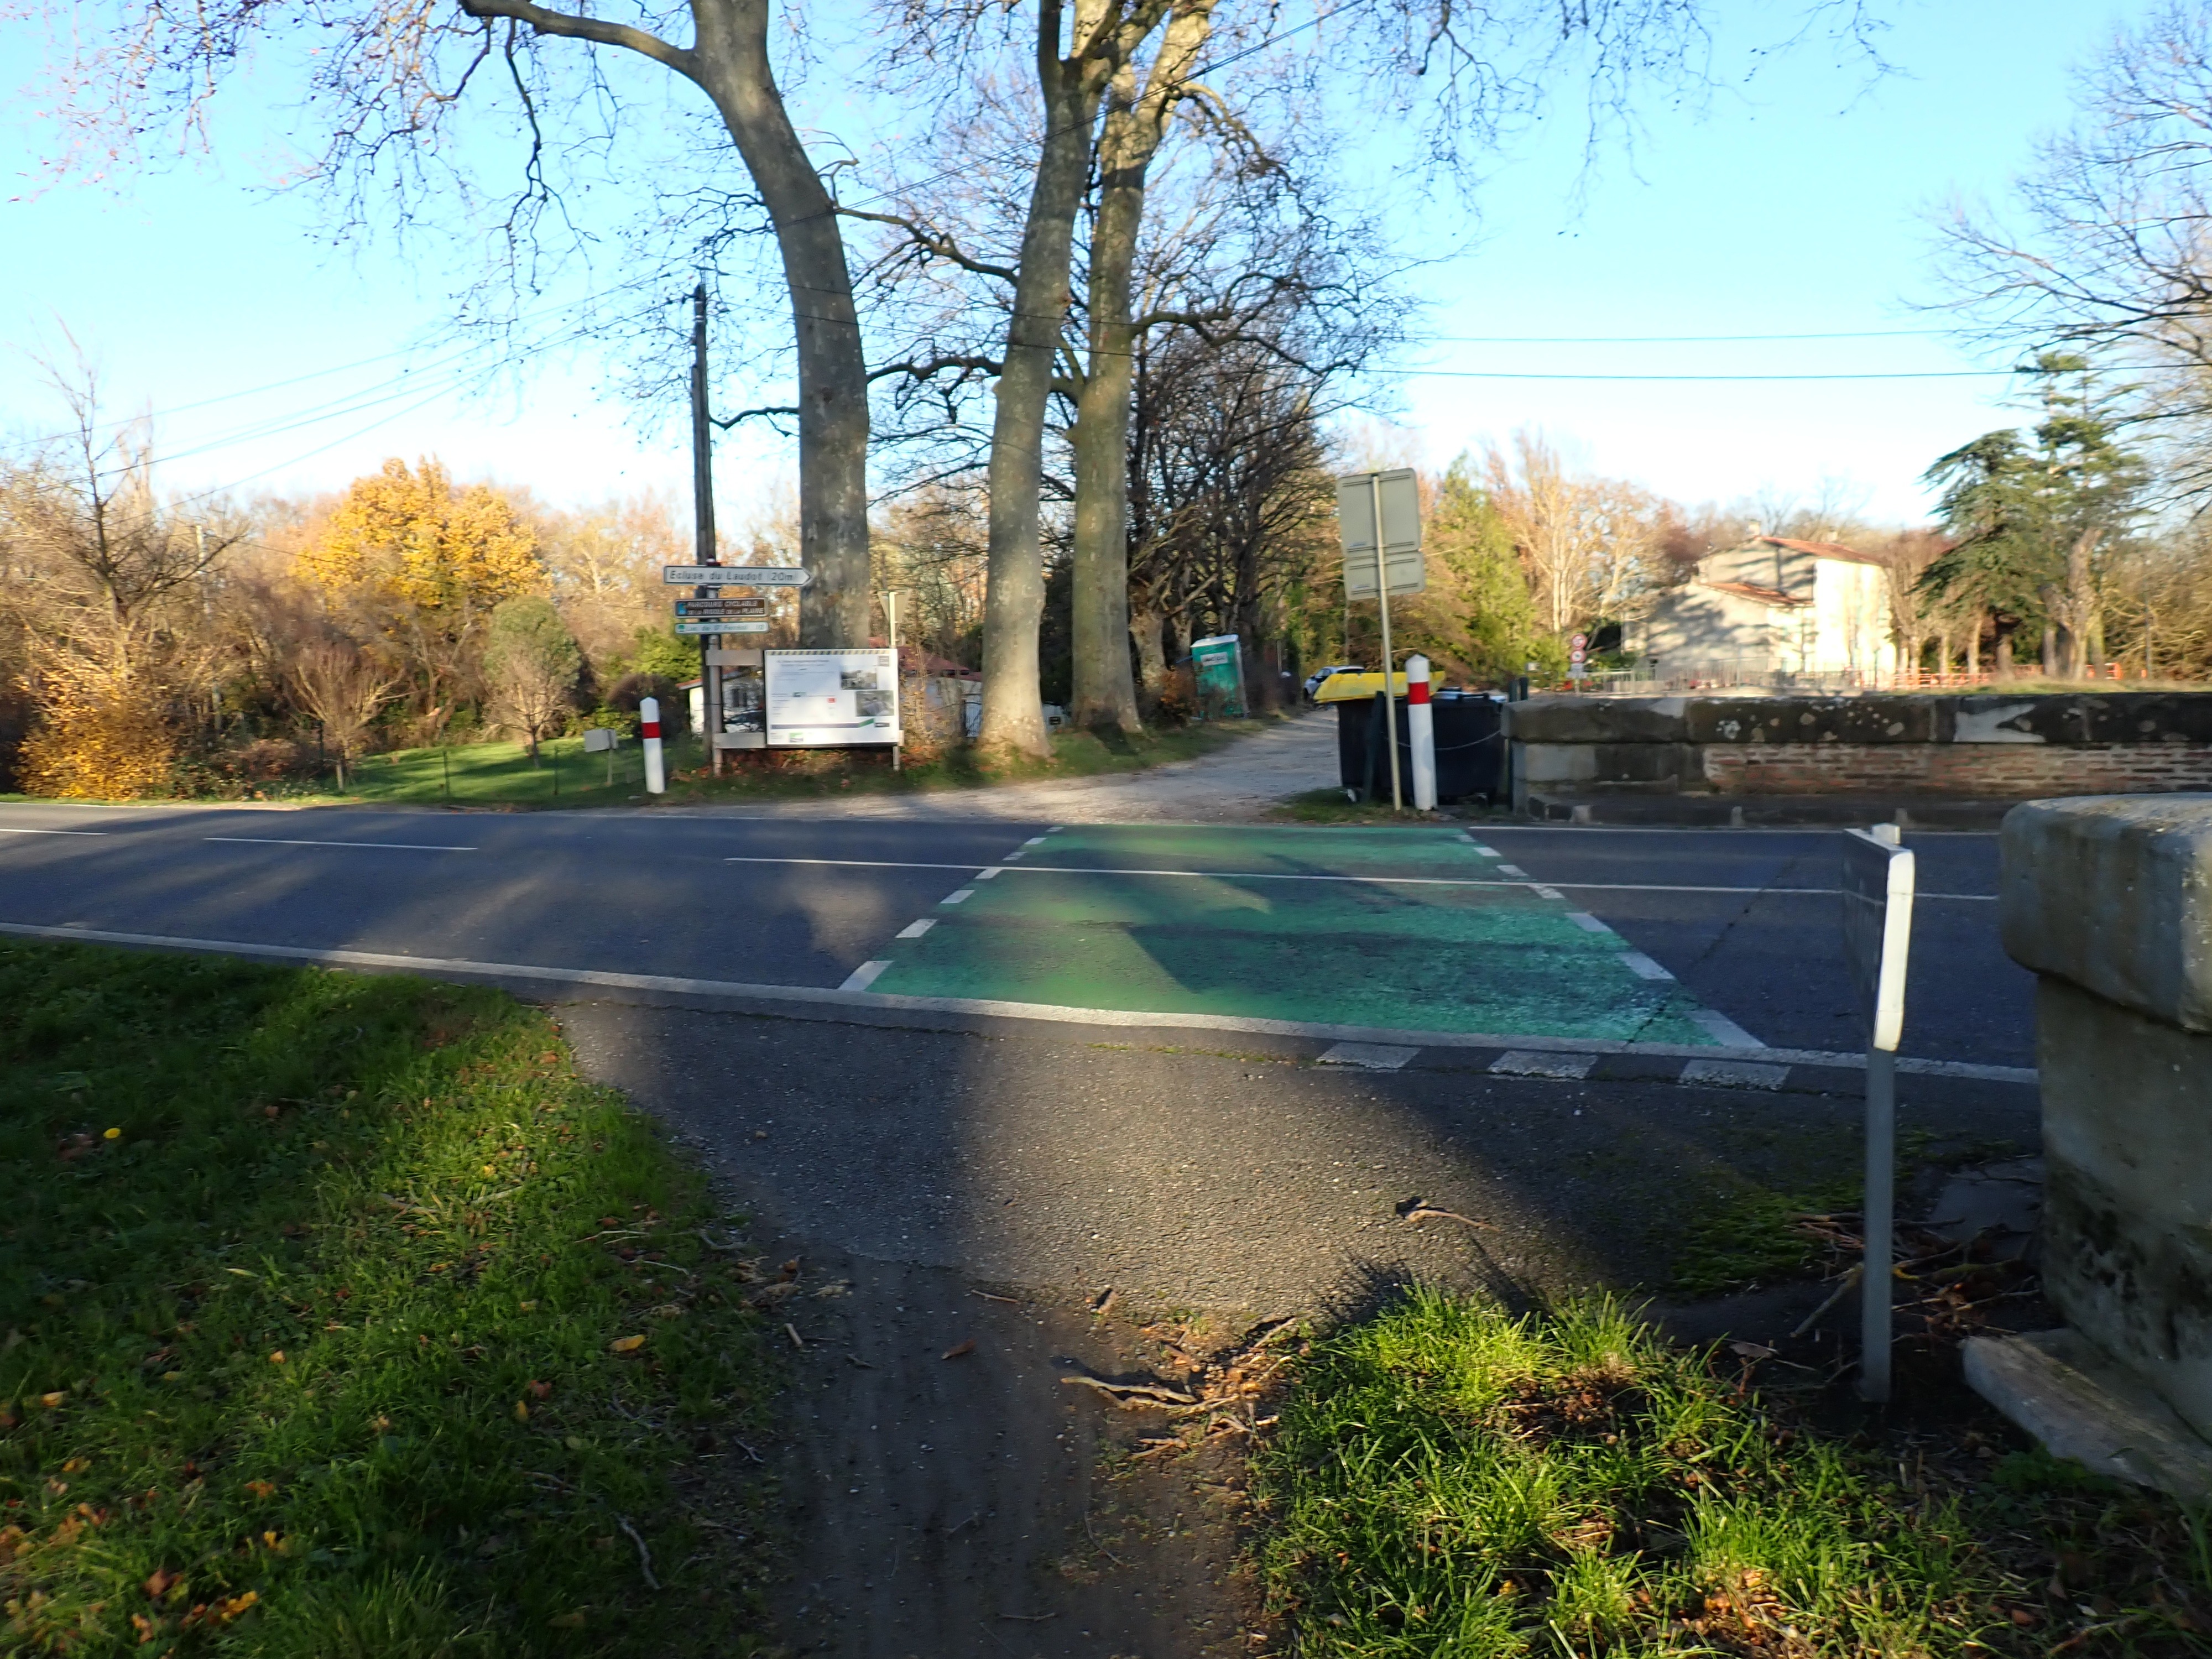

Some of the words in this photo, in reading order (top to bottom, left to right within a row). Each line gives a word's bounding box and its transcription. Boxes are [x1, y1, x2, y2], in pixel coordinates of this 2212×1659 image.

[670, 570, 704, 579] Ecluse
[709, 571, 722, 580] du
[727, 571, 762, 580] Laudot
